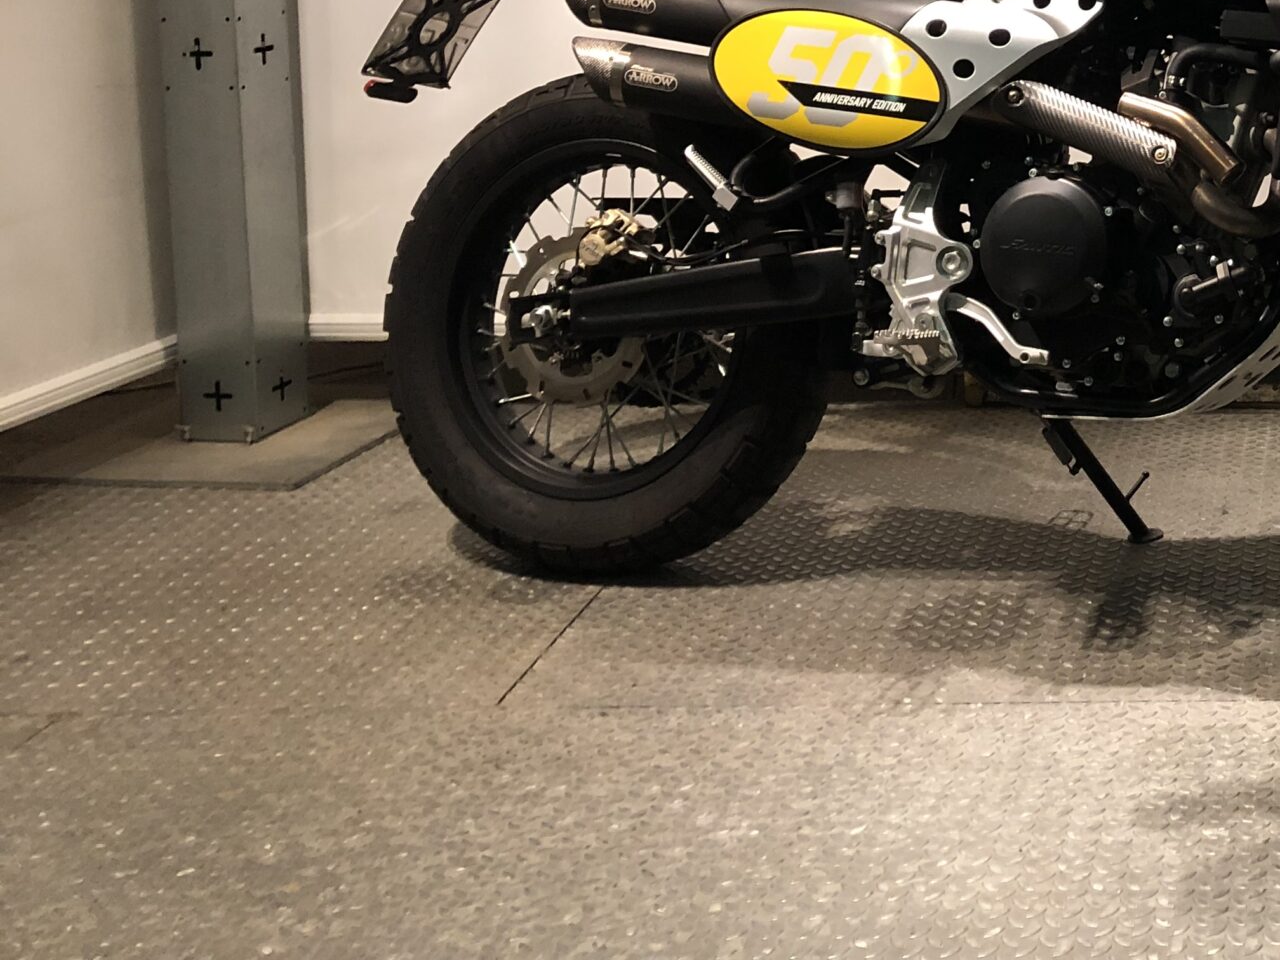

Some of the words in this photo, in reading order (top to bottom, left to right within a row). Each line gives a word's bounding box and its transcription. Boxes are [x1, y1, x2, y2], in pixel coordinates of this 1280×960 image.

[628, 70, 674, 87] ARROW
[812, 91, 873, 109] ANNIVERSARY
[872, 99, 907, 113] EDITION
